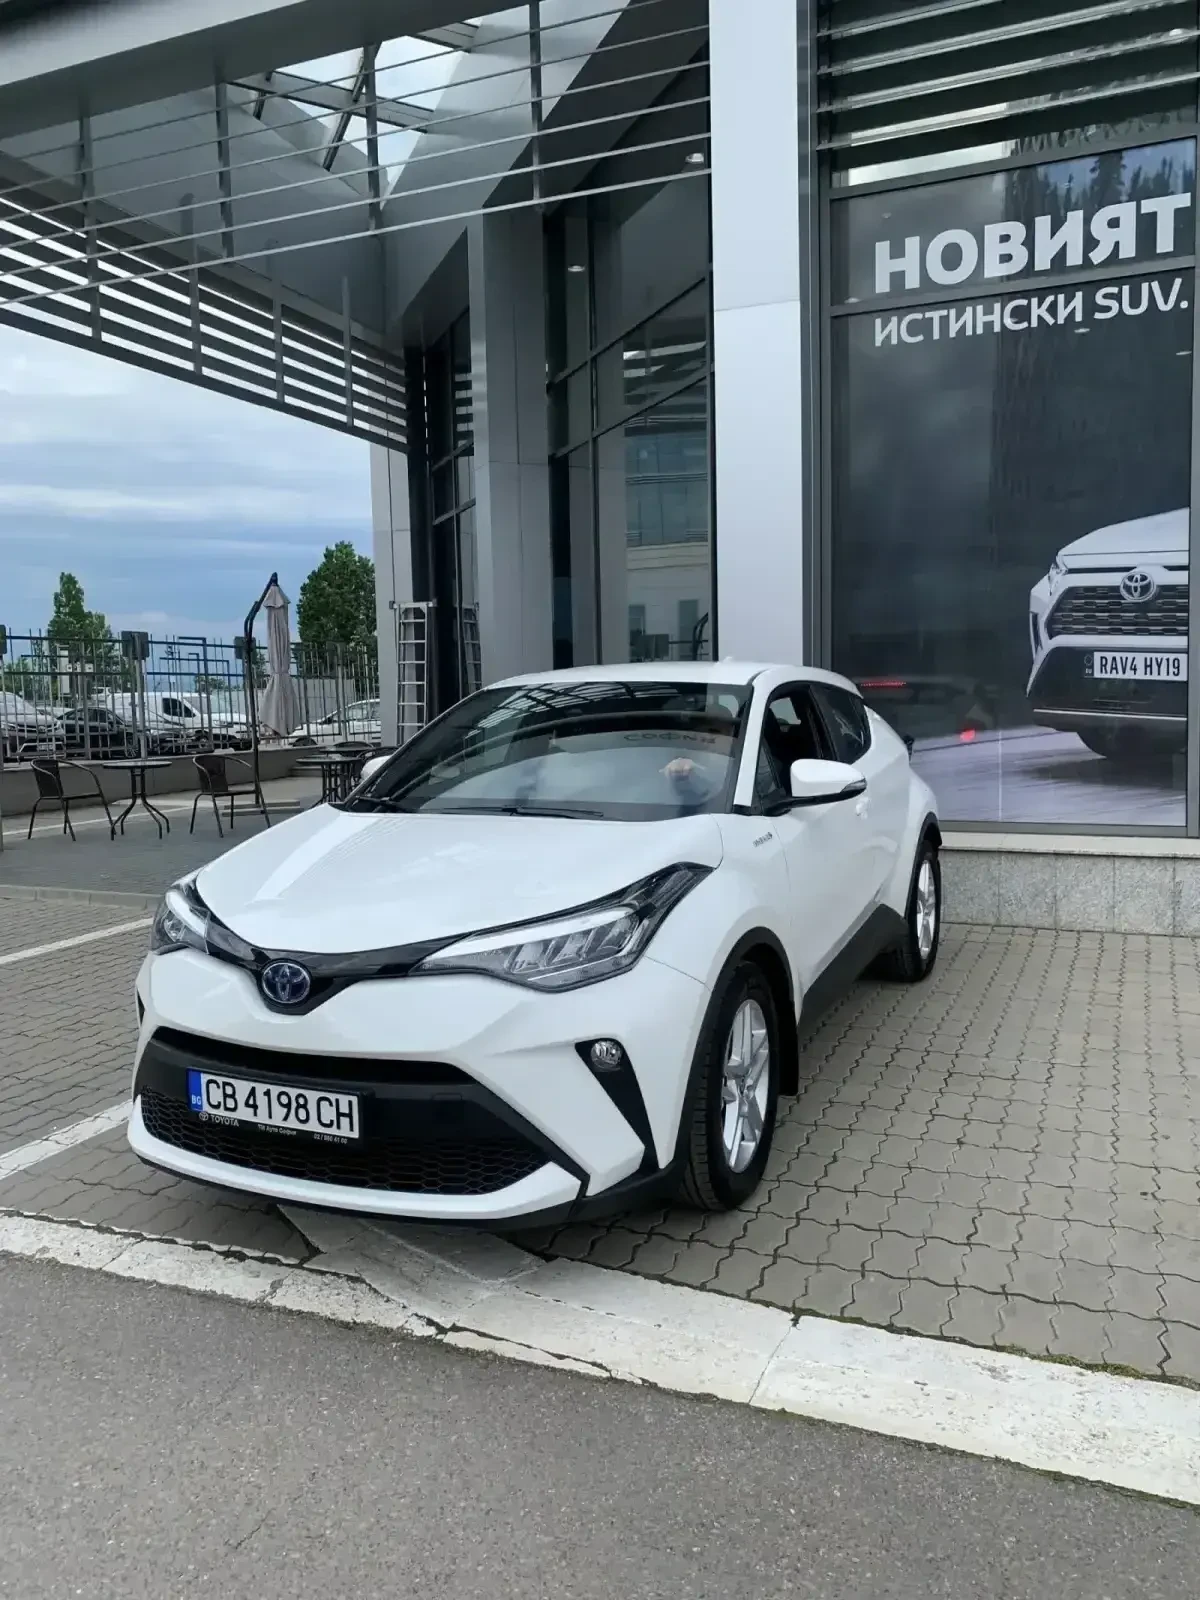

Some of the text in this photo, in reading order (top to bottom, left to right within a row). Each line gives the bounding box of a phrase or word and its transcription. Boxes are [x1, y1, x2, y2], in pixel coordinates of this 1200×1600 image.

[875, 192, 1191, 294] НОВИЯТ
[874, 277, 1189, 347] ИСТИНСКИ SUV.
[1100, 656, 1138, 675] RAV4
[1144, 657, 1181, 676] HY19
[191, 1094, 202, 1106] BG
[205, 1078, 354, 1132] CB 4198 CH
[210, 1114, 240, 1127] TOYOTA
